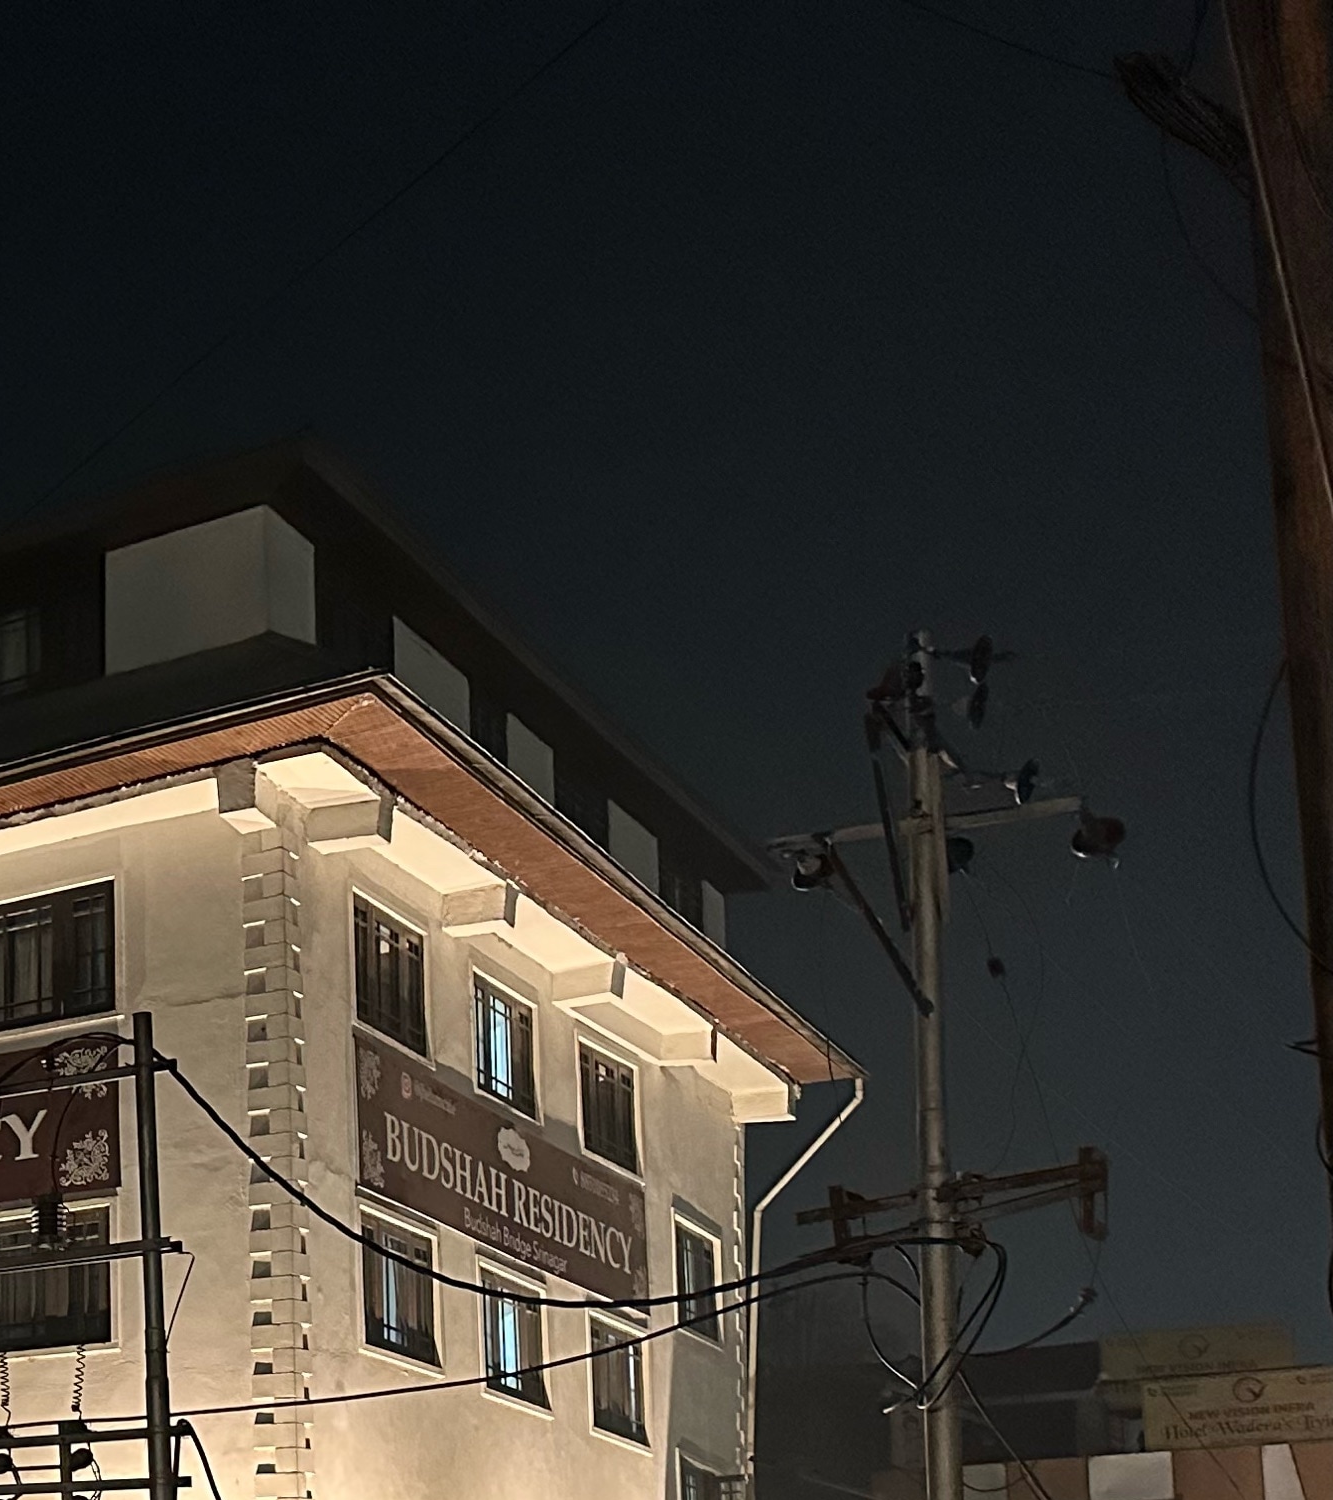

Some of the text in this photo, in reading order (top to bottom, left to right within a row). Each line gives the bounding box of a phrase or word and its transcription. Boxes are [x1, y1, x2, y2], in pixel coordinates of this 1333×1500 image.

[384, 1111, 633, 1275] BUDSHAH RESIDENCY
[463, 1206, 502, 1243] Budshah
[503, 1225, 532, 1260] Bridge
